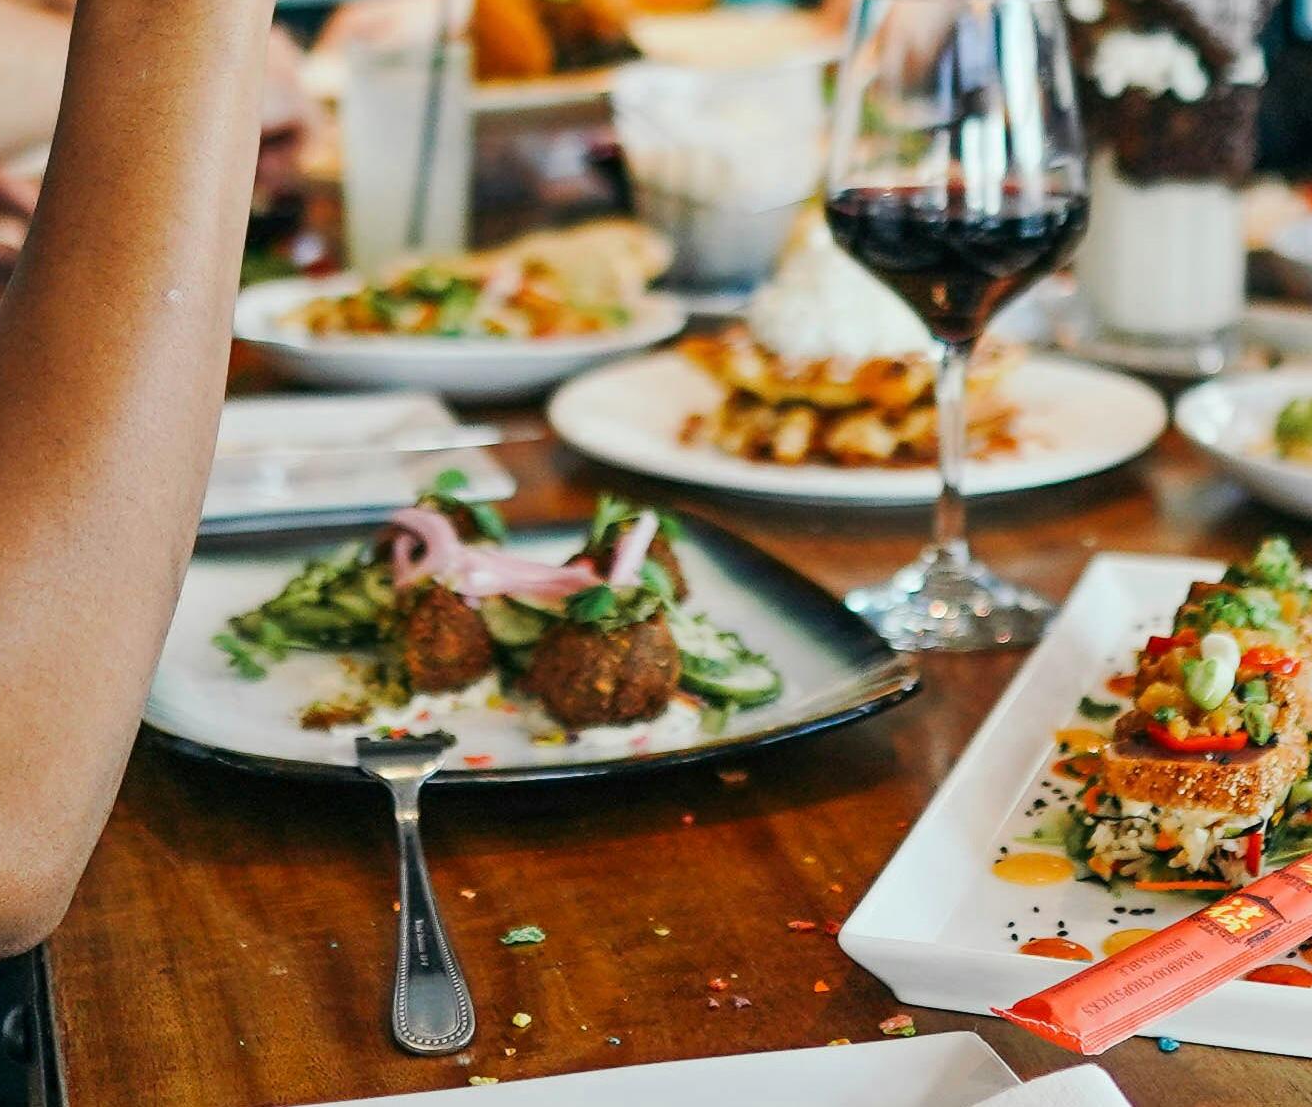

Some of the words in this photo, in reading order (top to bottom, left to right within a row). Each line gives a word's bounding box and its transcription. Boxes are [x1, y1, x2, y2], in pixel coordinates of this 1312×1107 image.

[1116, 938, 1187, 977] DISPOSABLE
[1151, 950, 1204, 981] BAMBOO
[1081, 974, 1156, 1017] CHOPSTICKS
